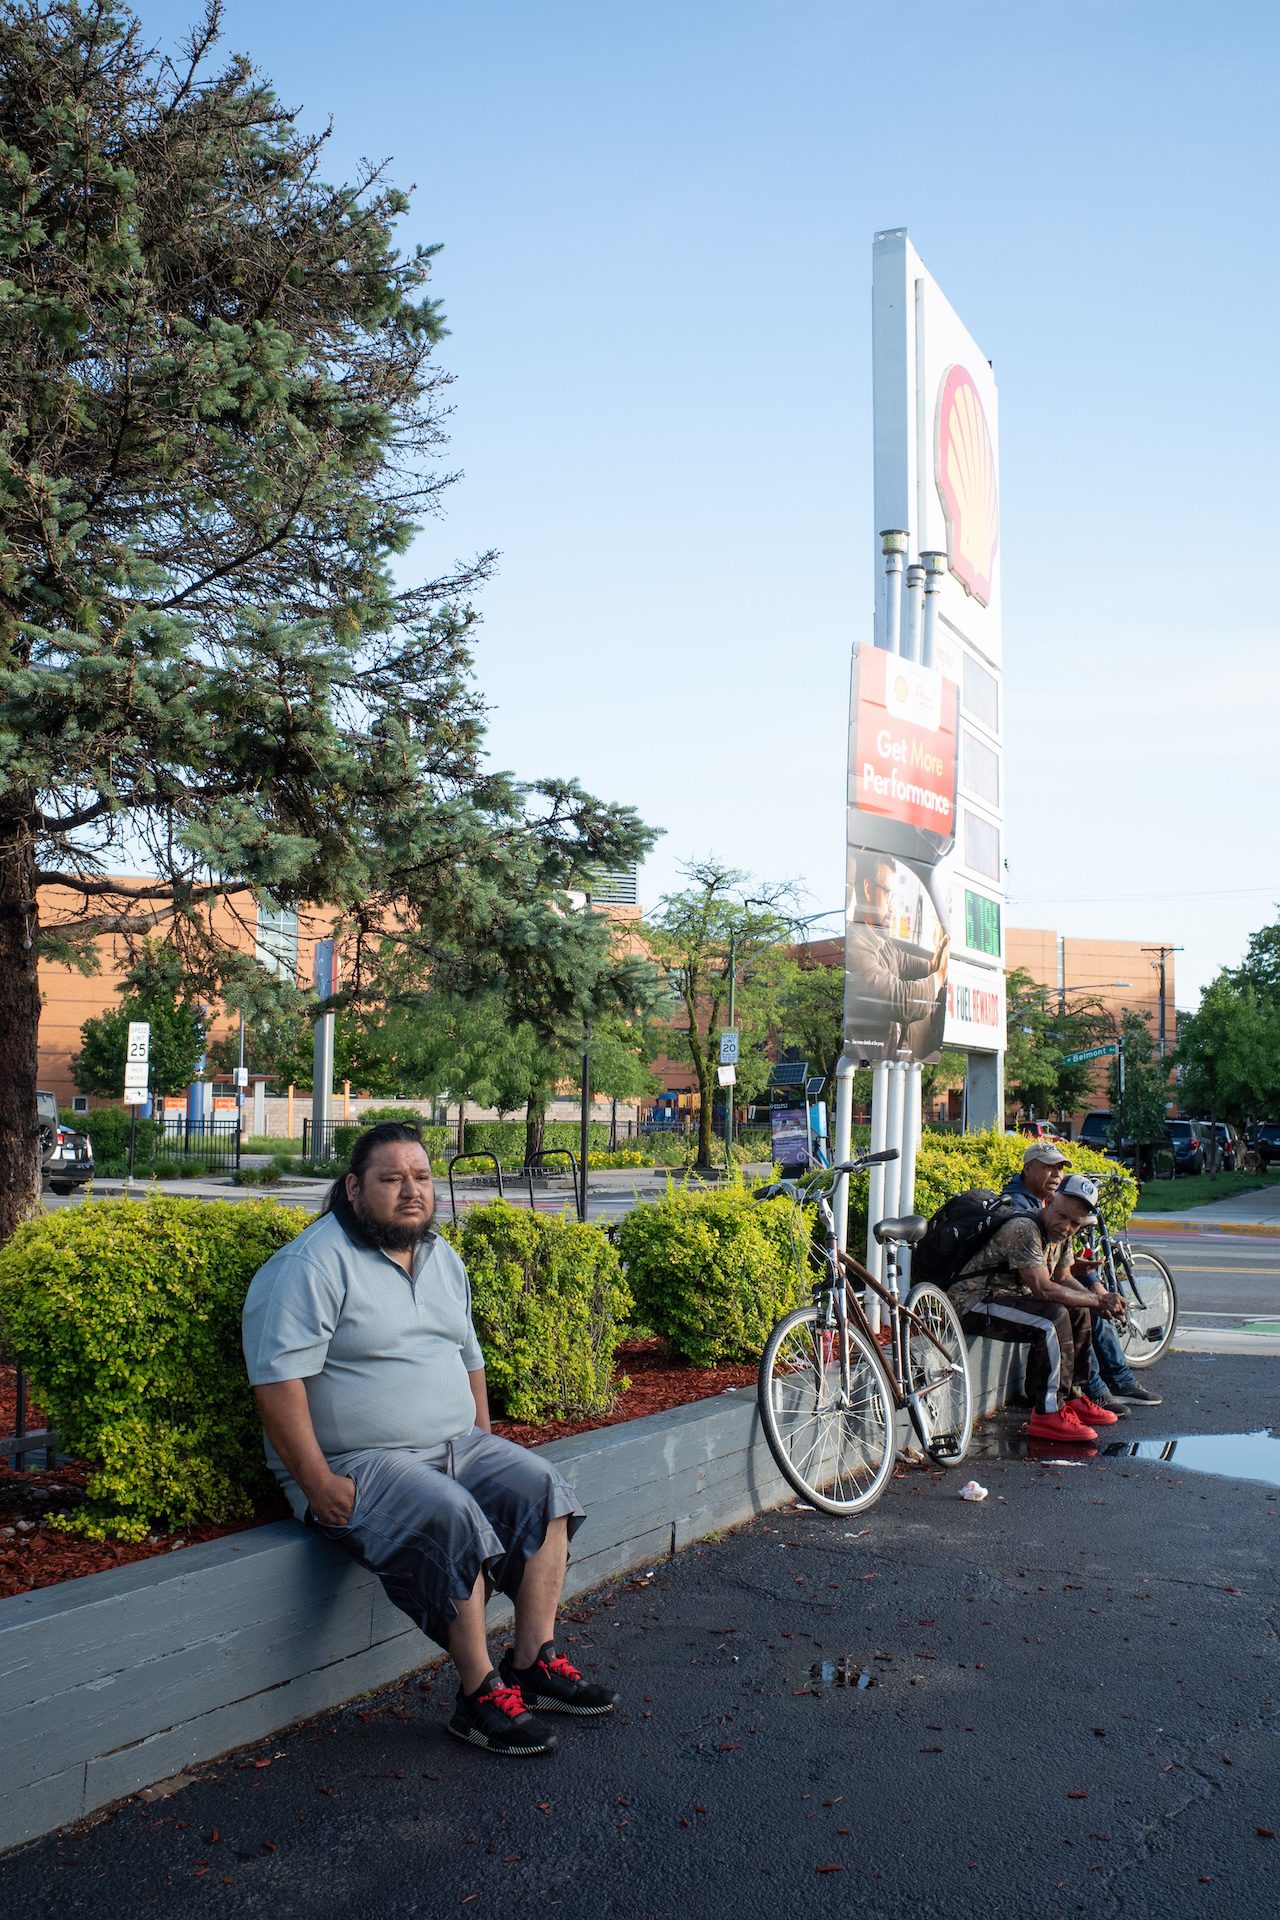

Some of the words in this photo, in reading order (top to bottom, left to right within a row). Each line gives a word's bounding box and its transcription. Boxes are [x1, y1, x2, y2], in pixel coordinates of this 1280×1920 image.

[877, 730, 907, 763] Get
[911, 740, 944, 777] More
[863, 763, 950, 815] Performance
[957, 985, 971, 1022] FUEL
[131, 1043, 146, 1056] 25
[722, 1043, 736, 1052] 20
[1072, 1048, 1106, 1062] Belmont
